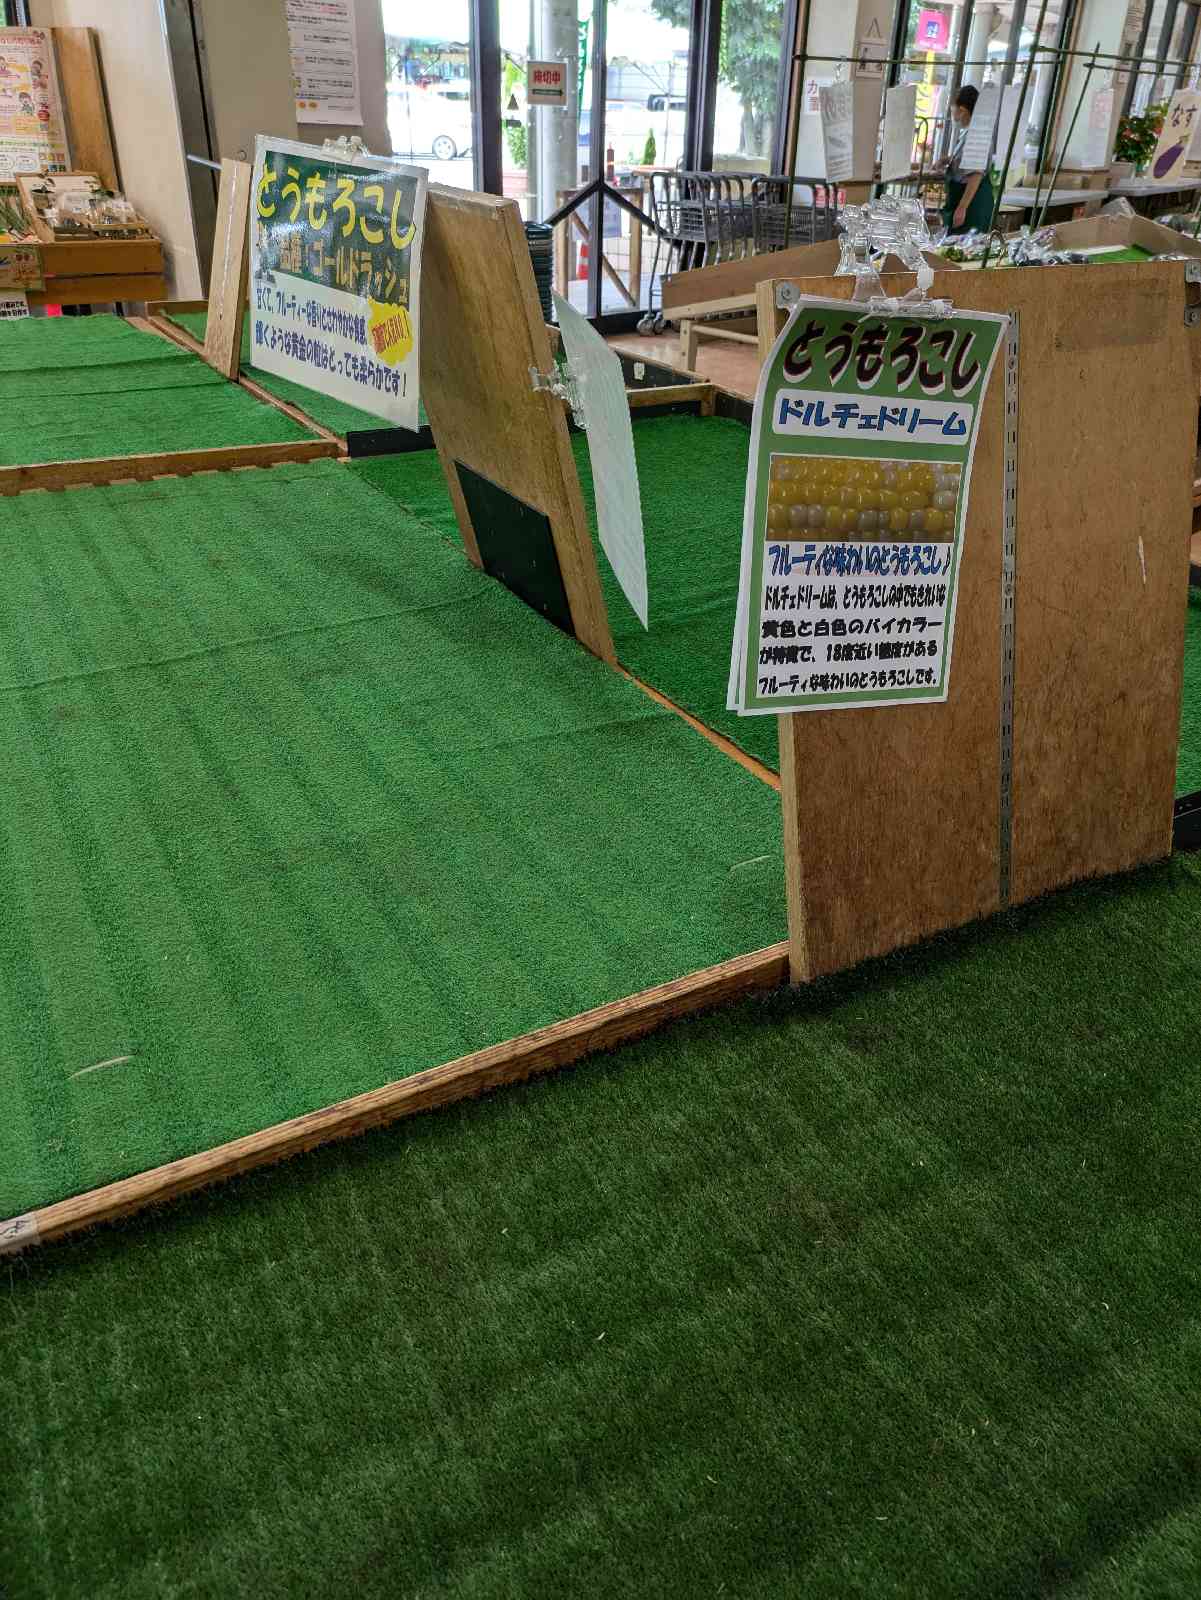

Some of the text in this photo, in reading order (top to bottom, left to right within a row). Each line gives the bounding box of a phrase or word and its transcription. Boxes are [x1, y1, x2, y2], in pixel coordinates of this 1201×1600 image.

[257, 163, 416, 250] とうもろこし
[783, 320, 982, 398] とうもろこし
[778, 398, 967, 436] ドルチェドリーム
[762, 616, 944, 638] 黄色と白色のバイカラー
